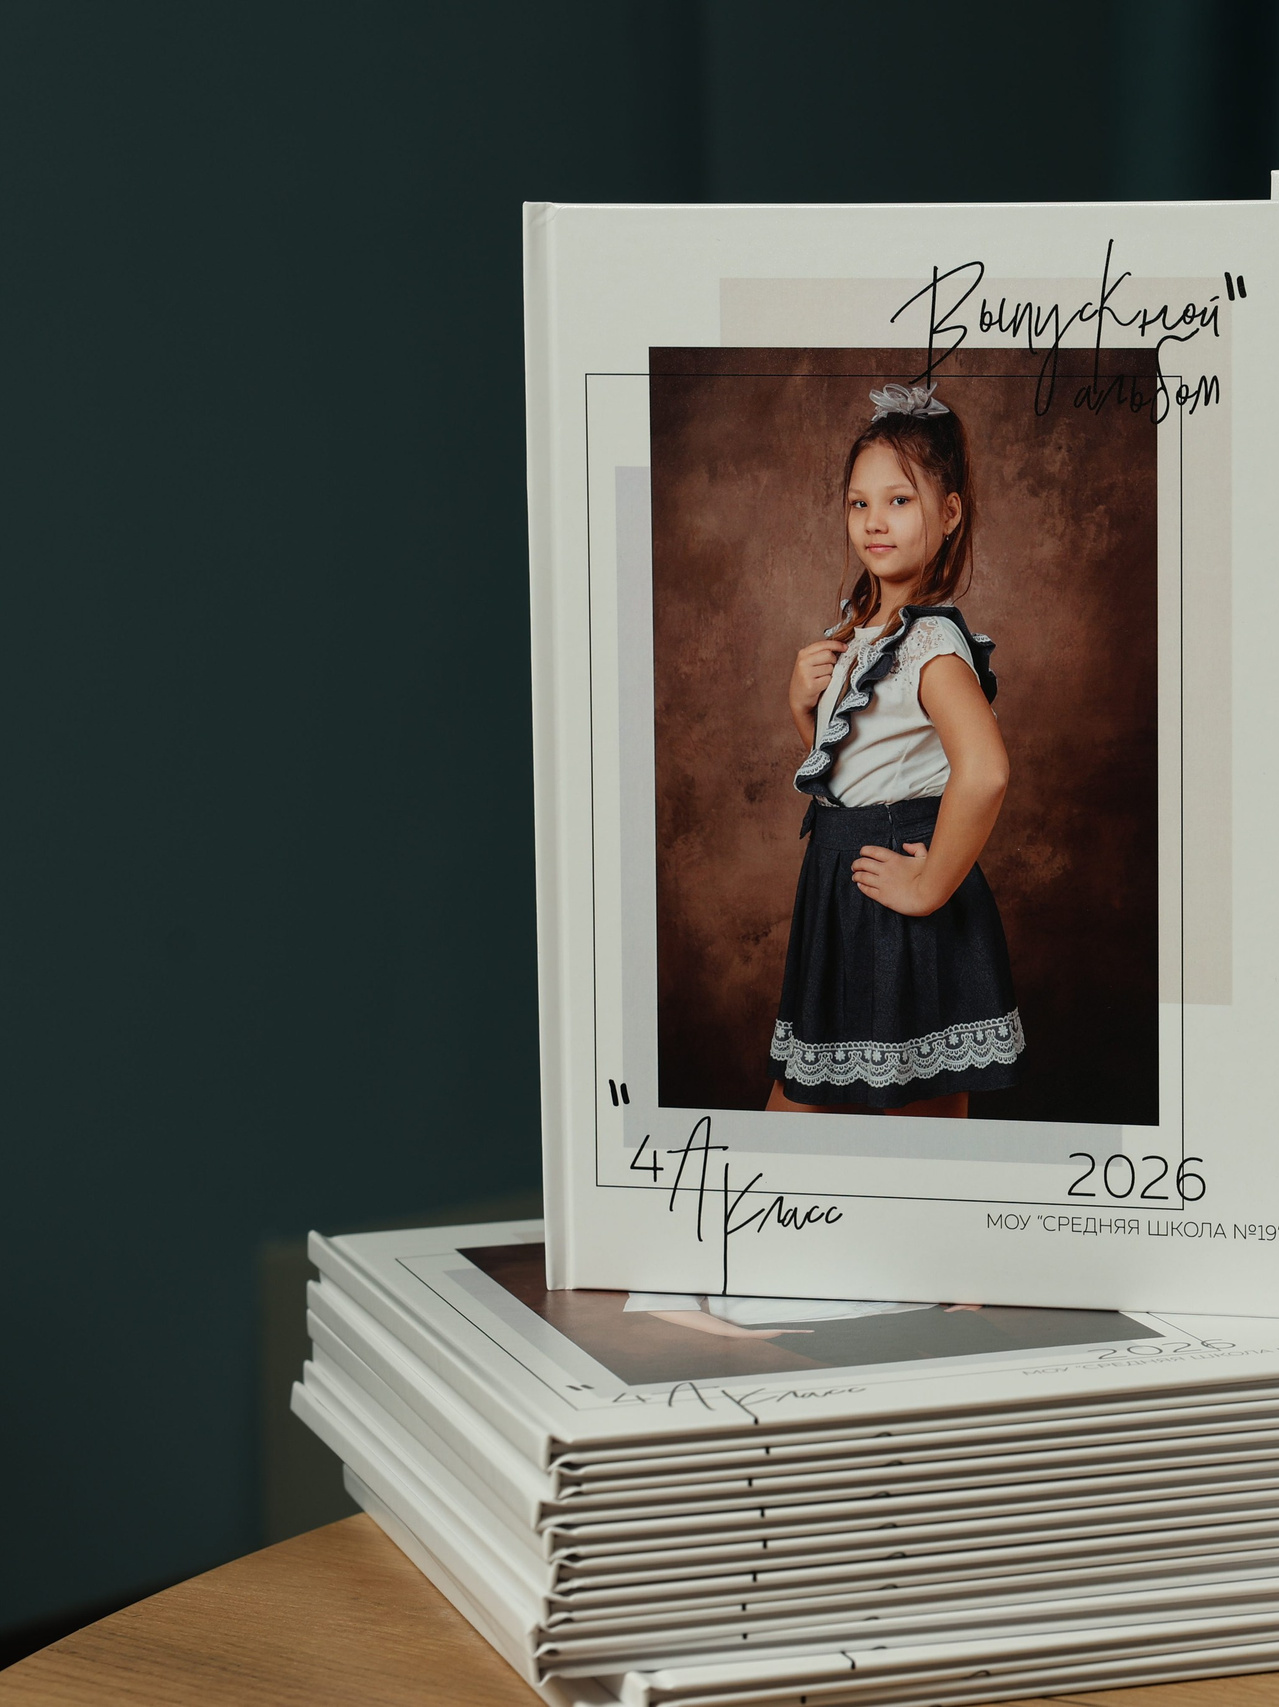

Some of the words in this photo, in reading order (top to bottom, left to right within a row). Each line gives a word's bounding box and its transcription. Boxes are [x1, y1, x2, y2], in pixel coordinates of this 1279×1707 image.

[1066, 1152, 1207, 1202] 2026
[986, 1213, 1032, 1231] МОУ
[1147, 1219, 1227, 1239] ШКОЛА
[1087, 1338, 1236, 1360] 2026
